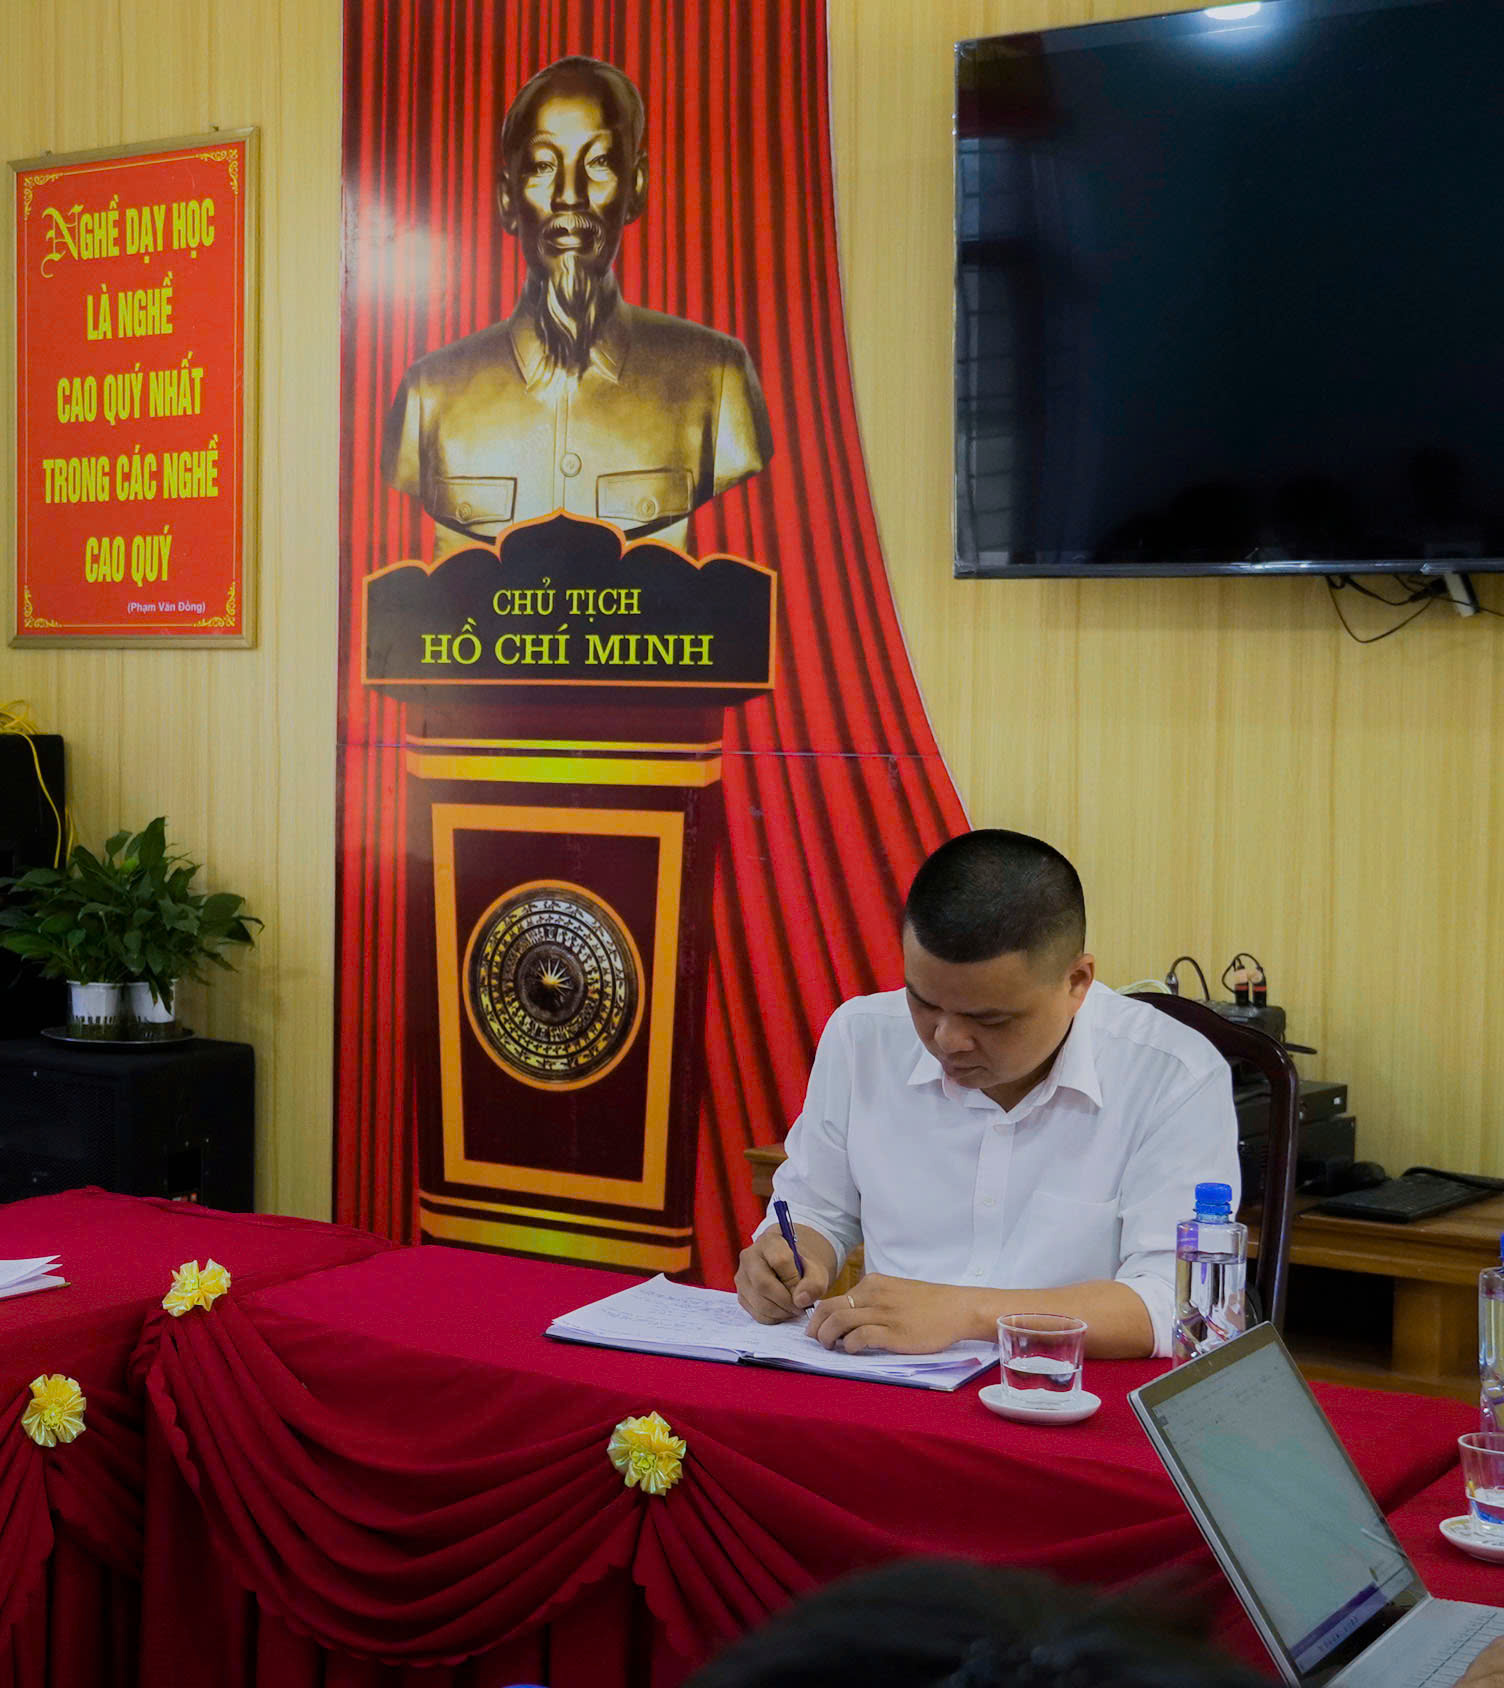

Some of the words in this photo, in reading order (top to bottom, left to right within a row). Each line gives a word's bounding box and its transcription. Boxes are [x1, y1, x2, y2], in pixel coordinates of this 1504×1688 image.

[41, 194, 119, 278] NGHỀ
[126, 204, 167, 264] DẠY
[173, 198, 216, 259] HỌC
[87, 284, 113, 341] LÀ
[118, 271, 173, 338] NGHỀ
[57, 376, 98, 424] CAO
[104, 363, 144, 426] QUÝ
[149, 351, 204, 418] NHẤT
[43, 456, 110, 504] TRONG
[116, 445, 158, 502] CÁC
[163, 434, 219, 499] NGHỀ
[85, 536, 125, 583] CAO
[131, 525, 172, 588] QUÝ
[127, 601, 156, 615] (Phạm
[492, 577, 556, 616] CHỦ
[566, 589, 642, 623] TỊCH
[421, 617, 483, 666] HỒ
[494, 624, 571, 666] CHÍ
[585, 634, 714, 666] MINH
